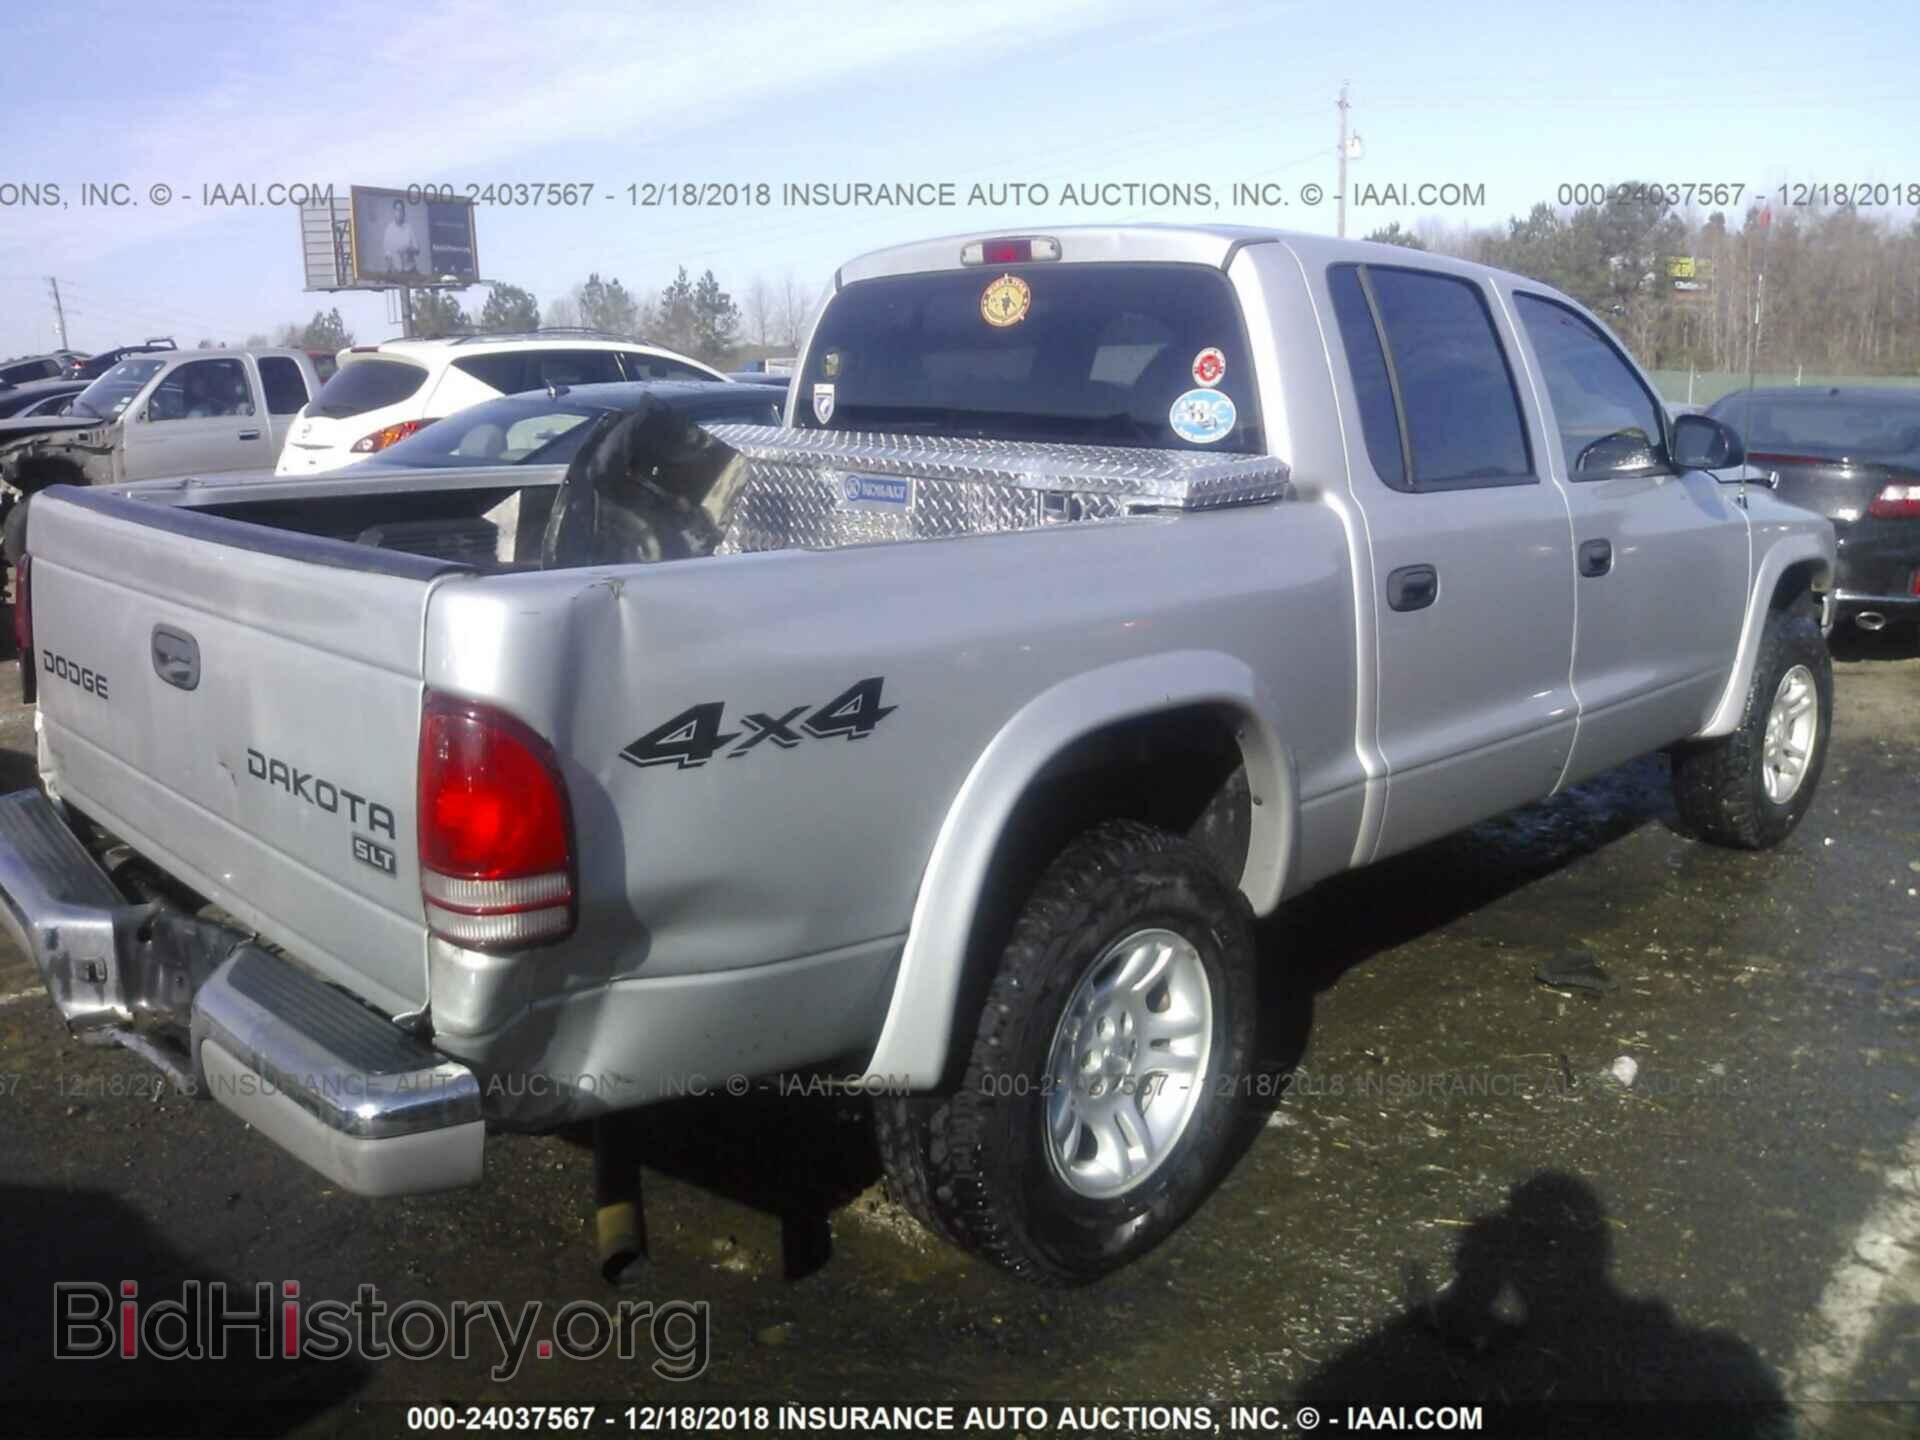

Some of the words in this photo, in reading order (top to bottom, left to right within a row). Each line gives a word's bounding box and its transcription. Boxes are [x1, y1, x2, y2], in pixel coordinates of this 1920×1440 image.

[43, 649, 108, 700] DODGE
[618, 676, 899, 770] 4x4
[246, 748, 396, 840] DAKOTA
[353, 838, 395, 872] SLT
